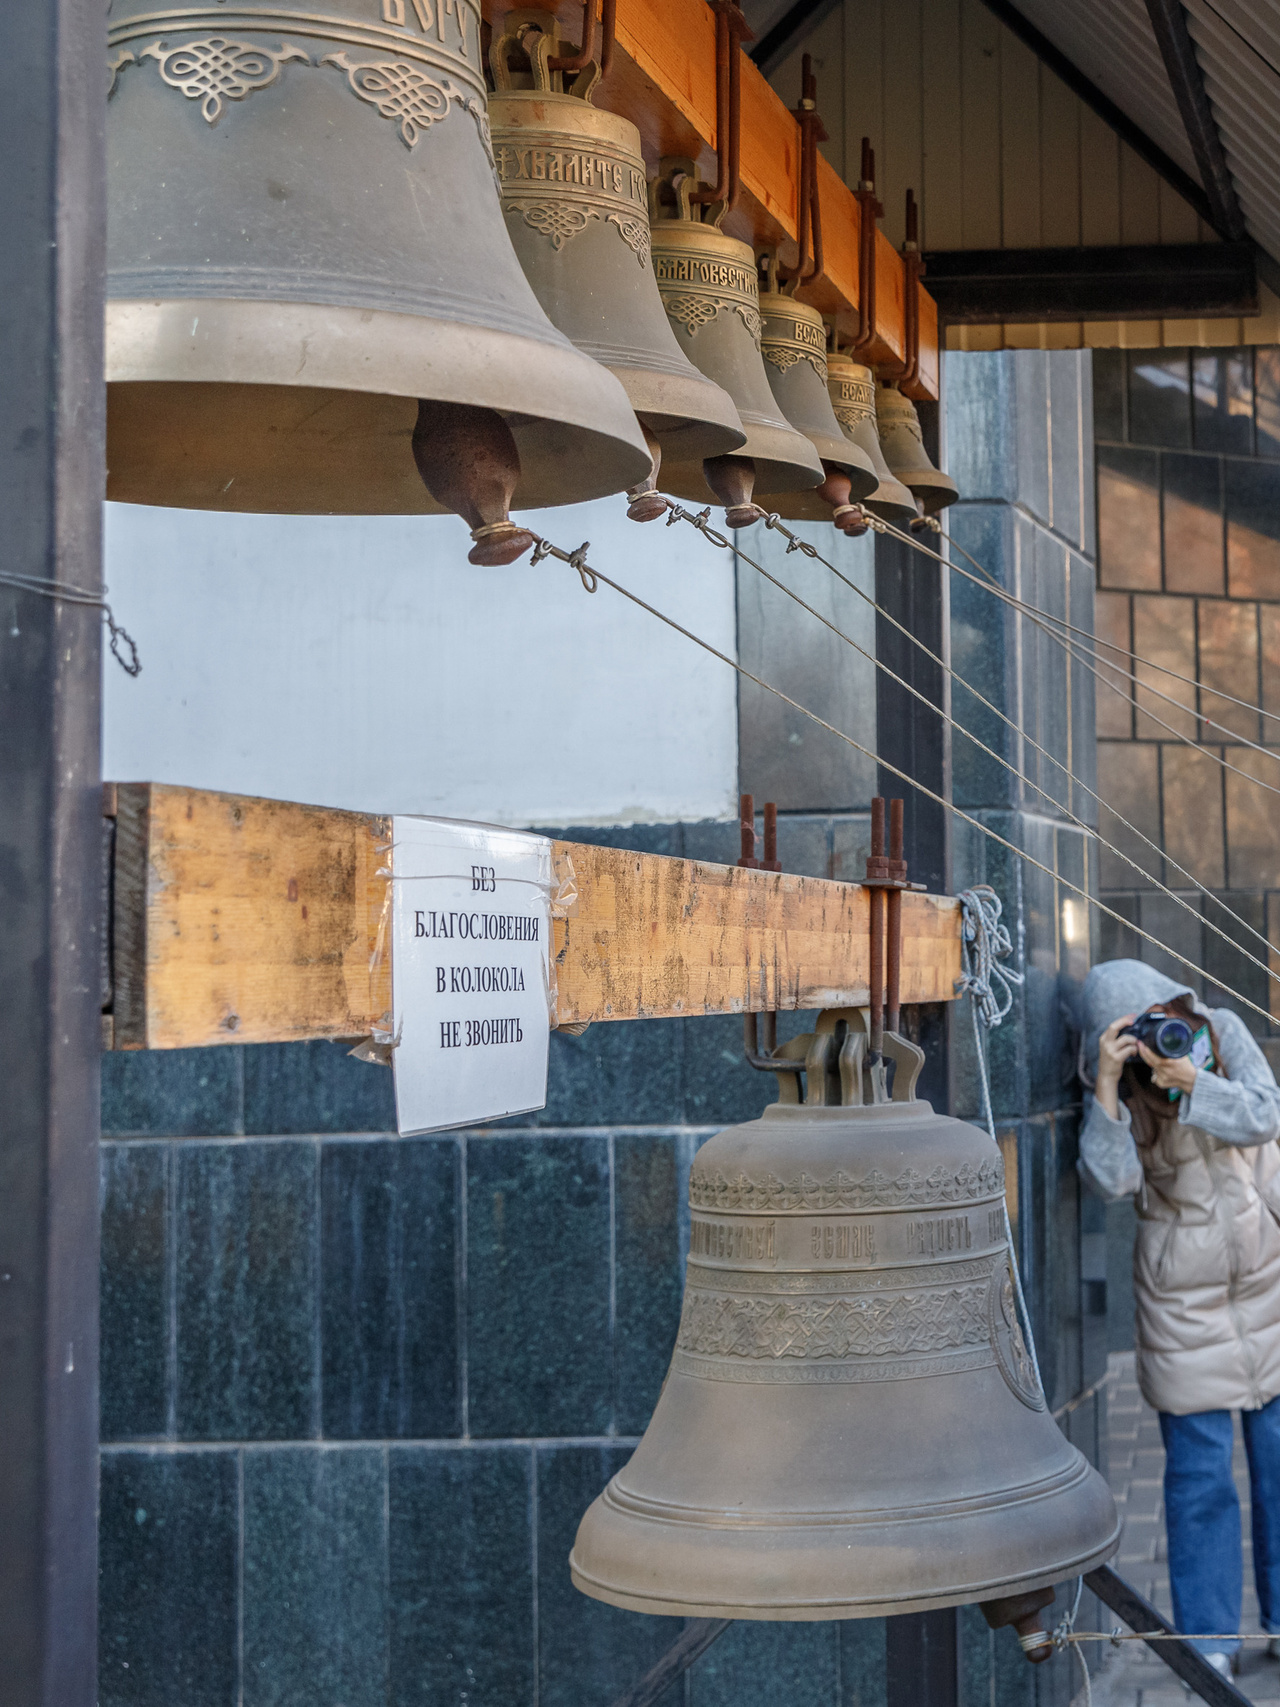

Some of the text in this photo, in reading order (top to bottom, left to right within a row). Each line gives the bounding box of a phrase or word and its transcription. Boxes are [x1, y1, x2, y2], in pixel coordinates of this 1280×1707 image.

[471, 865, 496, 893] БЕЗ
[415, 911, 540, 942] БЛАГОСЛОВЕНИЯ
[436, 966, 525, 993] В КОЛОКОЛА
[440, 1018, 523, 1049] НЕ ЗВОНИТЬ
